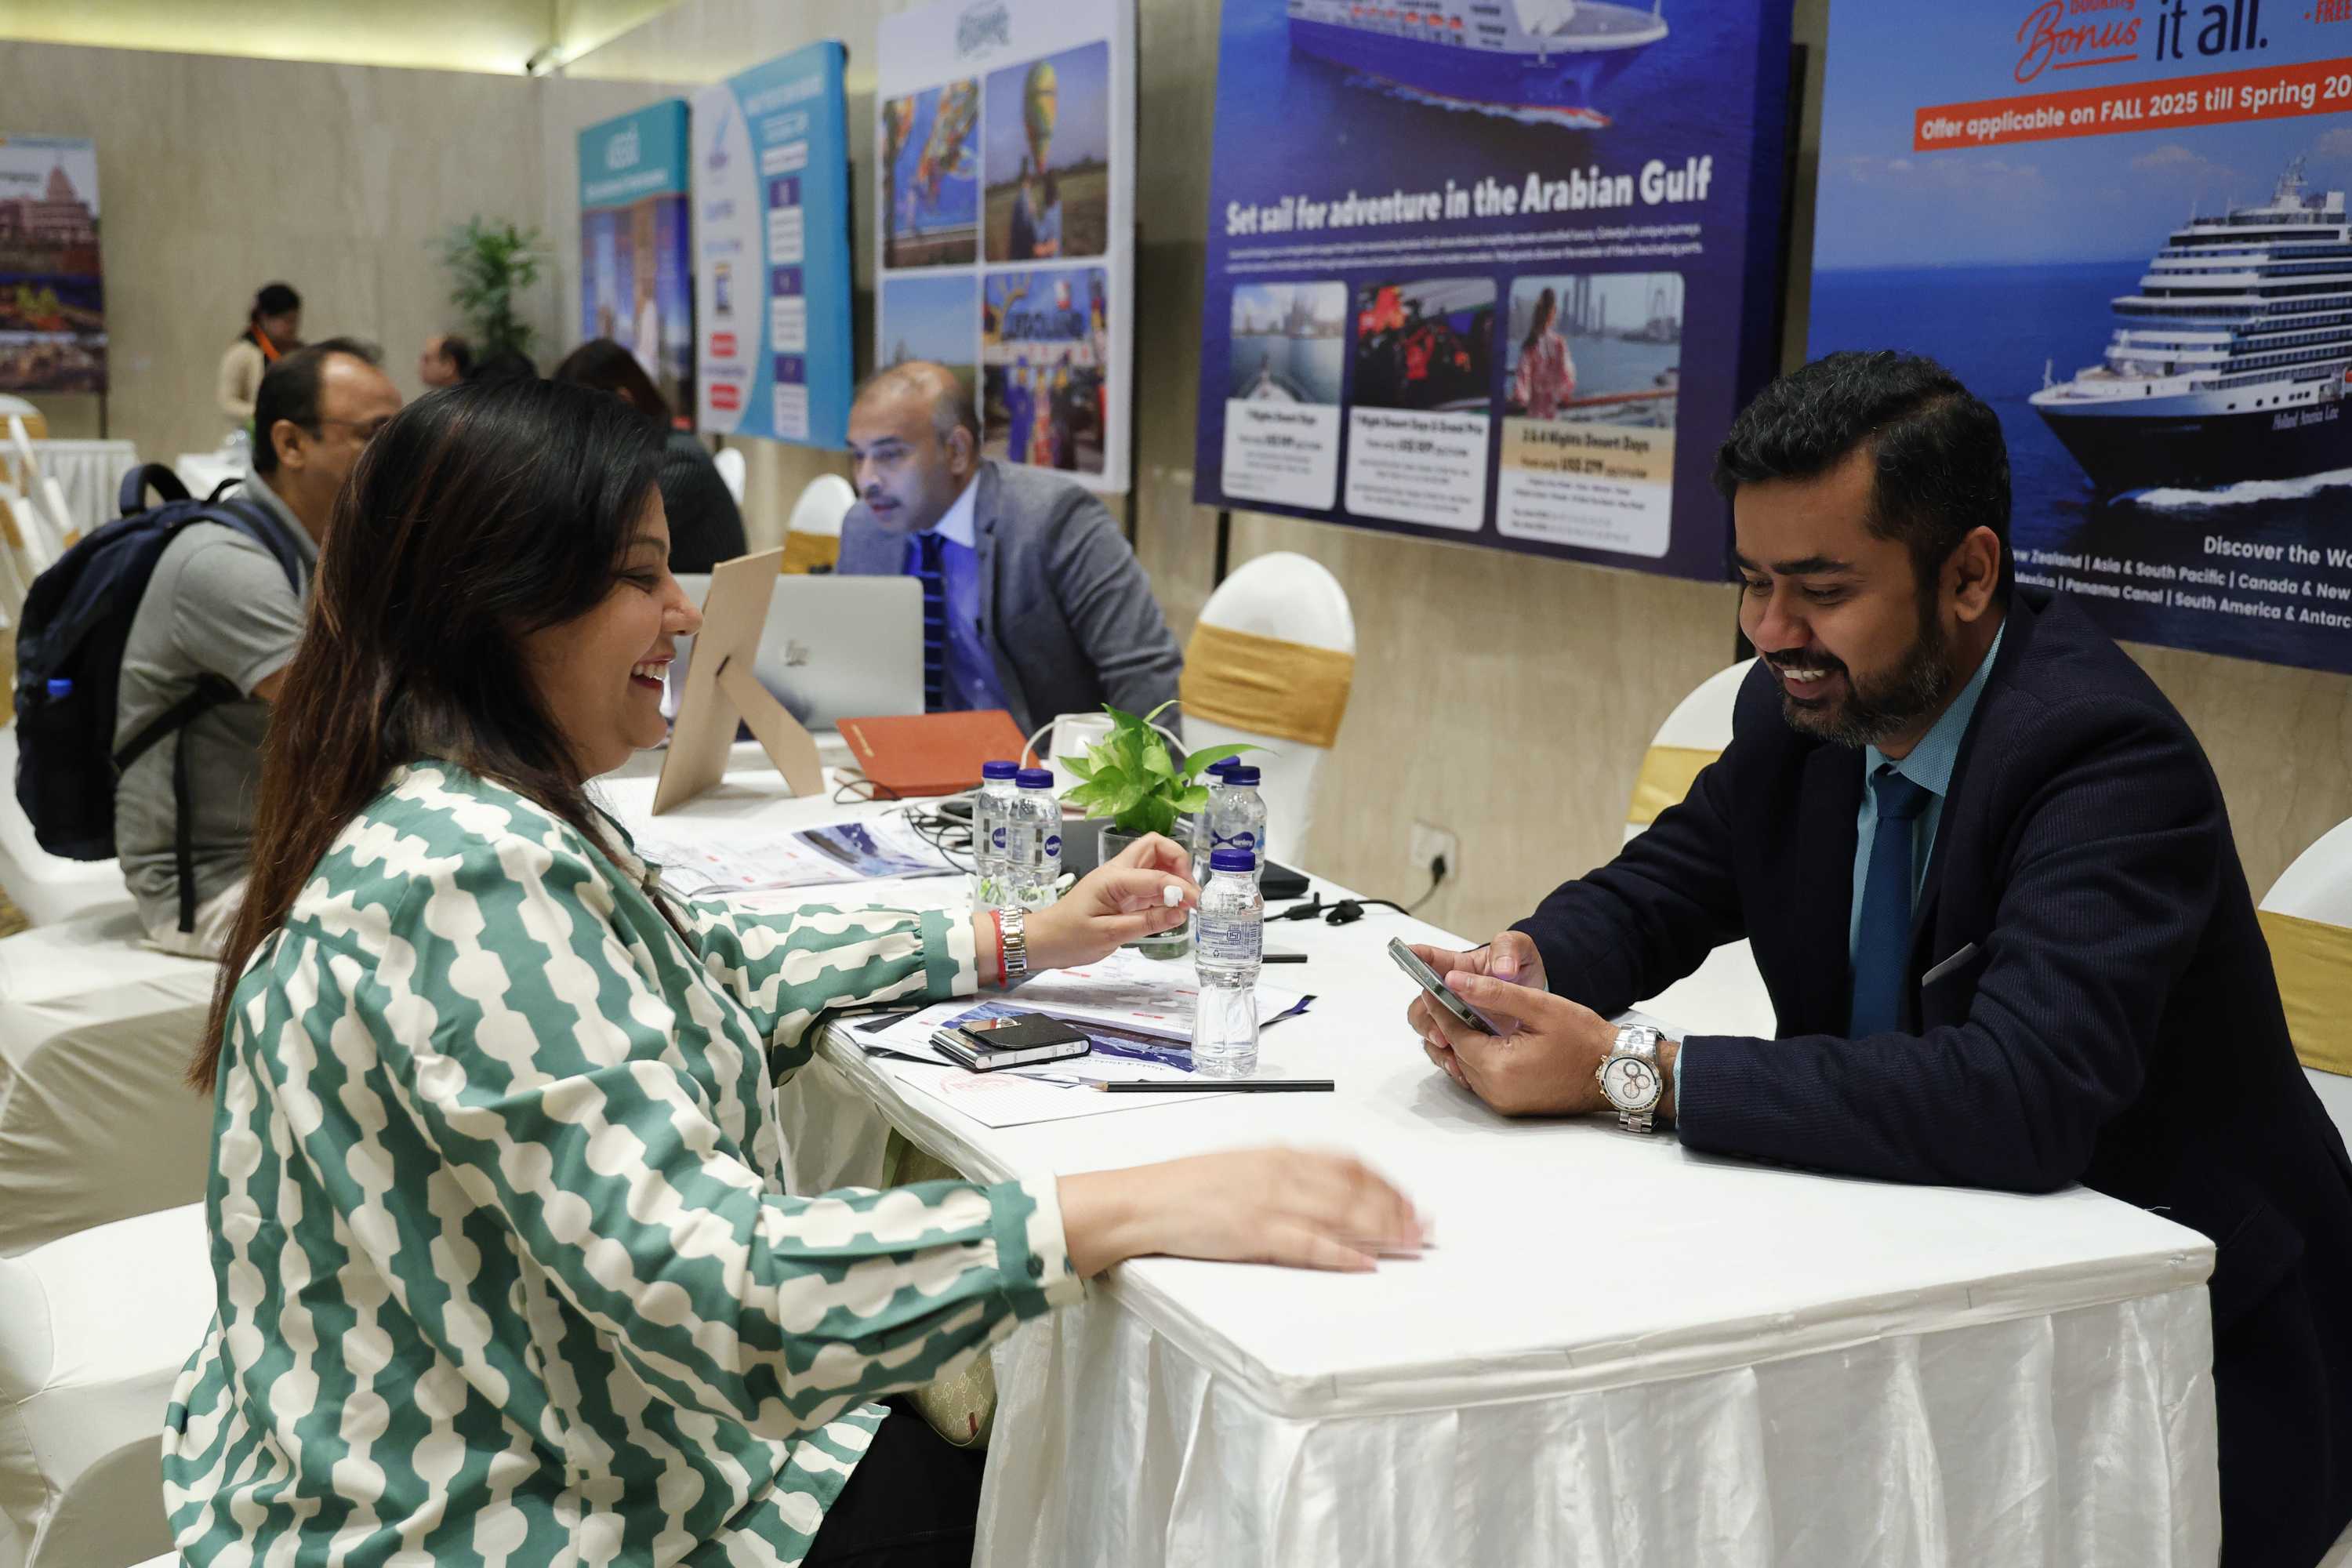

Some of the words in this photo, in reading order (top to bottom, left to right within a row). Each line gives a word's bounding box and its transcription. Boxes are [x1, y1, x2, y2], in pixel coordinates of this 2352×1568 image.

[2014, 1, 2143, 83] Bonus
[2157, 0, 2187, 61] it
[2198, 0, 2267, 56] all.
[1922, 117, 1964, 140] Offer
[1966, 107, 2065, 140] applicable
[2070, 106, 2095, 125] on
[2100, 96, 2143, 122] FALL
[2149, 91, 2198, 117] 2025
[2205, 87, 2233, 111] till
[2240, 79, 2316, 114] Spring
[1226, 200, 1258, 236] Set
[1261, 196, 1294, 233] sail
[1296, 196, 1327, 230] for
[1329, 189, 1441, 228] adventure
[1445, 179, 1469, 219] in
[1474, 176, 1519, 217] the
[1520, 165, 1634, 214] Arabian
[1639, 154, 1712, 205] Gulf
[2013, 549, 2030, 563] ew
[2031, 549, 2082, 568] Zealand
[2092, 557, 2121, 573] Asia
[2123, 560, 2132, 575] &
[2136, 561, 2176, 580] South
[2179, 566, 2227, 586] Pacific
[2238, 573, 2298, 594] Canada
[2301, 581, 2312, 596] &
[2317, 583, 2351, 601] New
[2204, 535, 2285, 561] Discover
[2288, 544, 2321, 564] the
[2065, 578, 2121, 598] Panama
[2122, 586, 2163, 604] Canal
[2175, 592, 2216, 611] South
[2220, 597, 2281, 619] America
[2285, 605, 2295, 621] &
